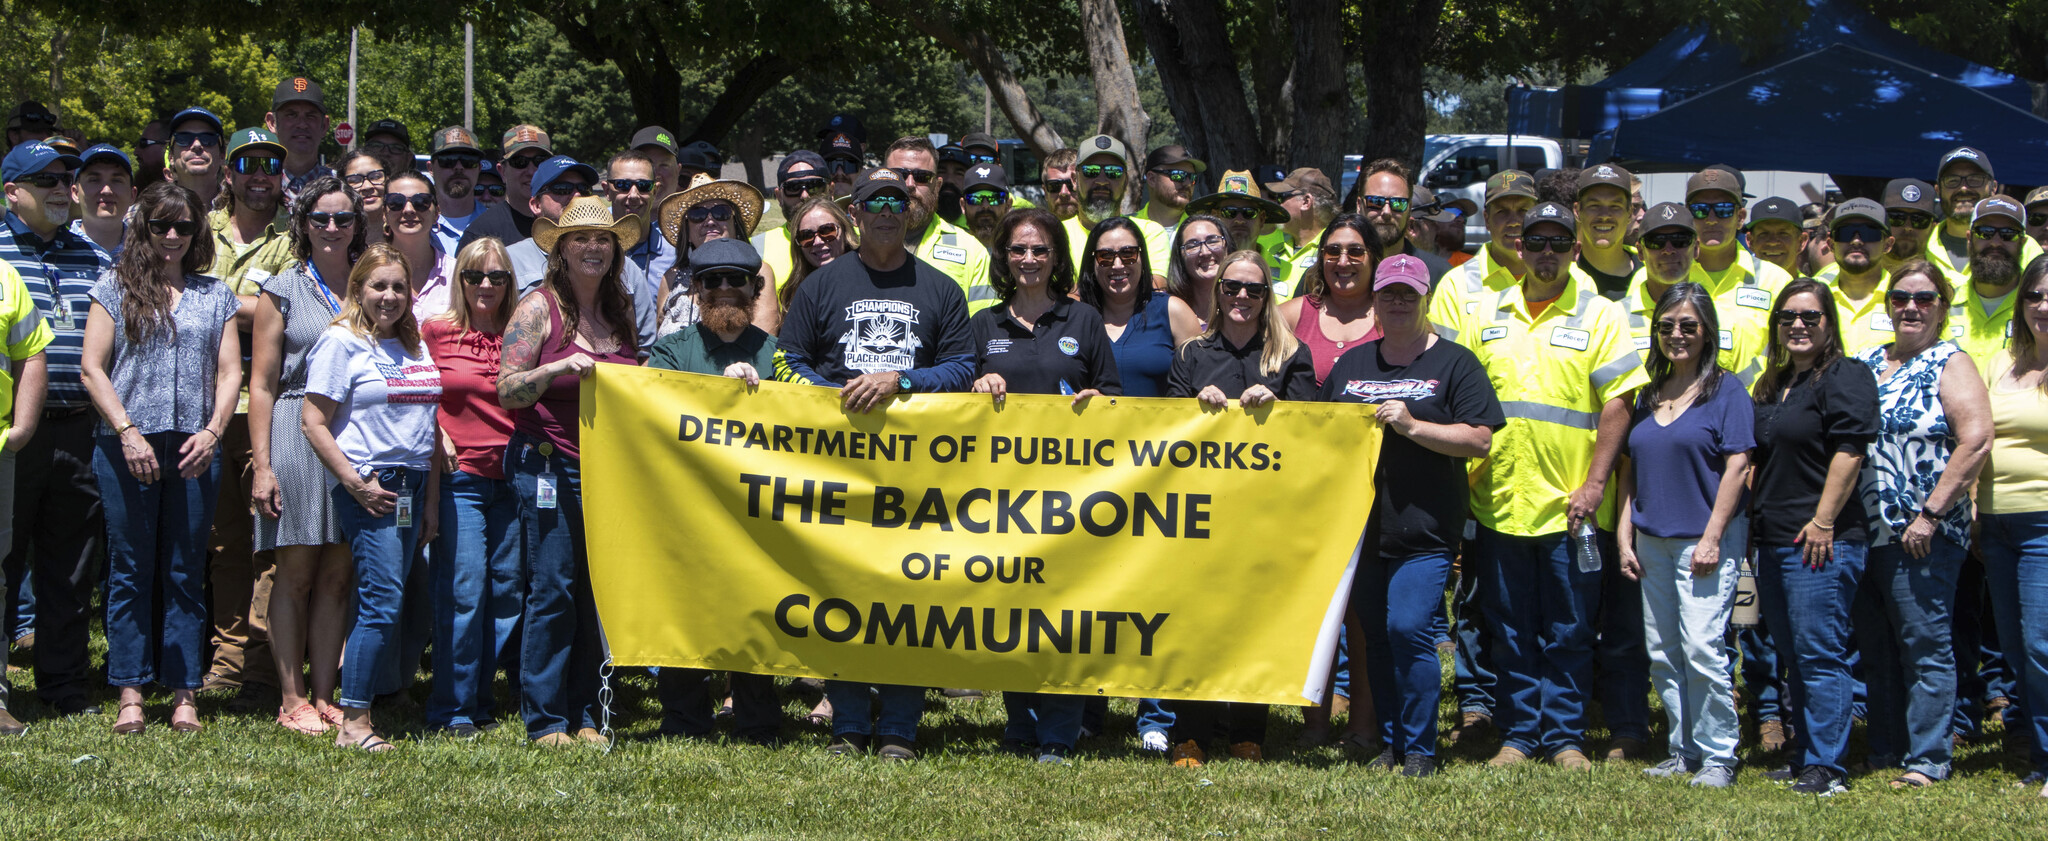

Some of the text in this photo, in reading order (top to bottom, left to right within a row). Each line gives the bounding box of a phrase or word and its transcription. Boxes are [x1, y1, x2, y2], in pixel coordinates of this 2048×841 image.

[248, 131, 267, 144] A's
[336, 130, 353, 138] STOP
[1502, 172, 1517, 189] P
[942, 249, 962, 257] Placer
[1746, 294, 1767, 302] Placer
[855, 301, 910, 315] CHAMPIONS
[1563, 333, 1585, 342] Placer
[846, 353, 912, 368] PLACER COUNTY
[678, 414, 1282, 472] DEPARTMENT OF PUBLIC WORKS:
[740, 473, 1212, 540] THE BACKBONE
[901, 552, 1046, 584] OF OUR
[775, 594, 1170, 656] COMMUNITY
